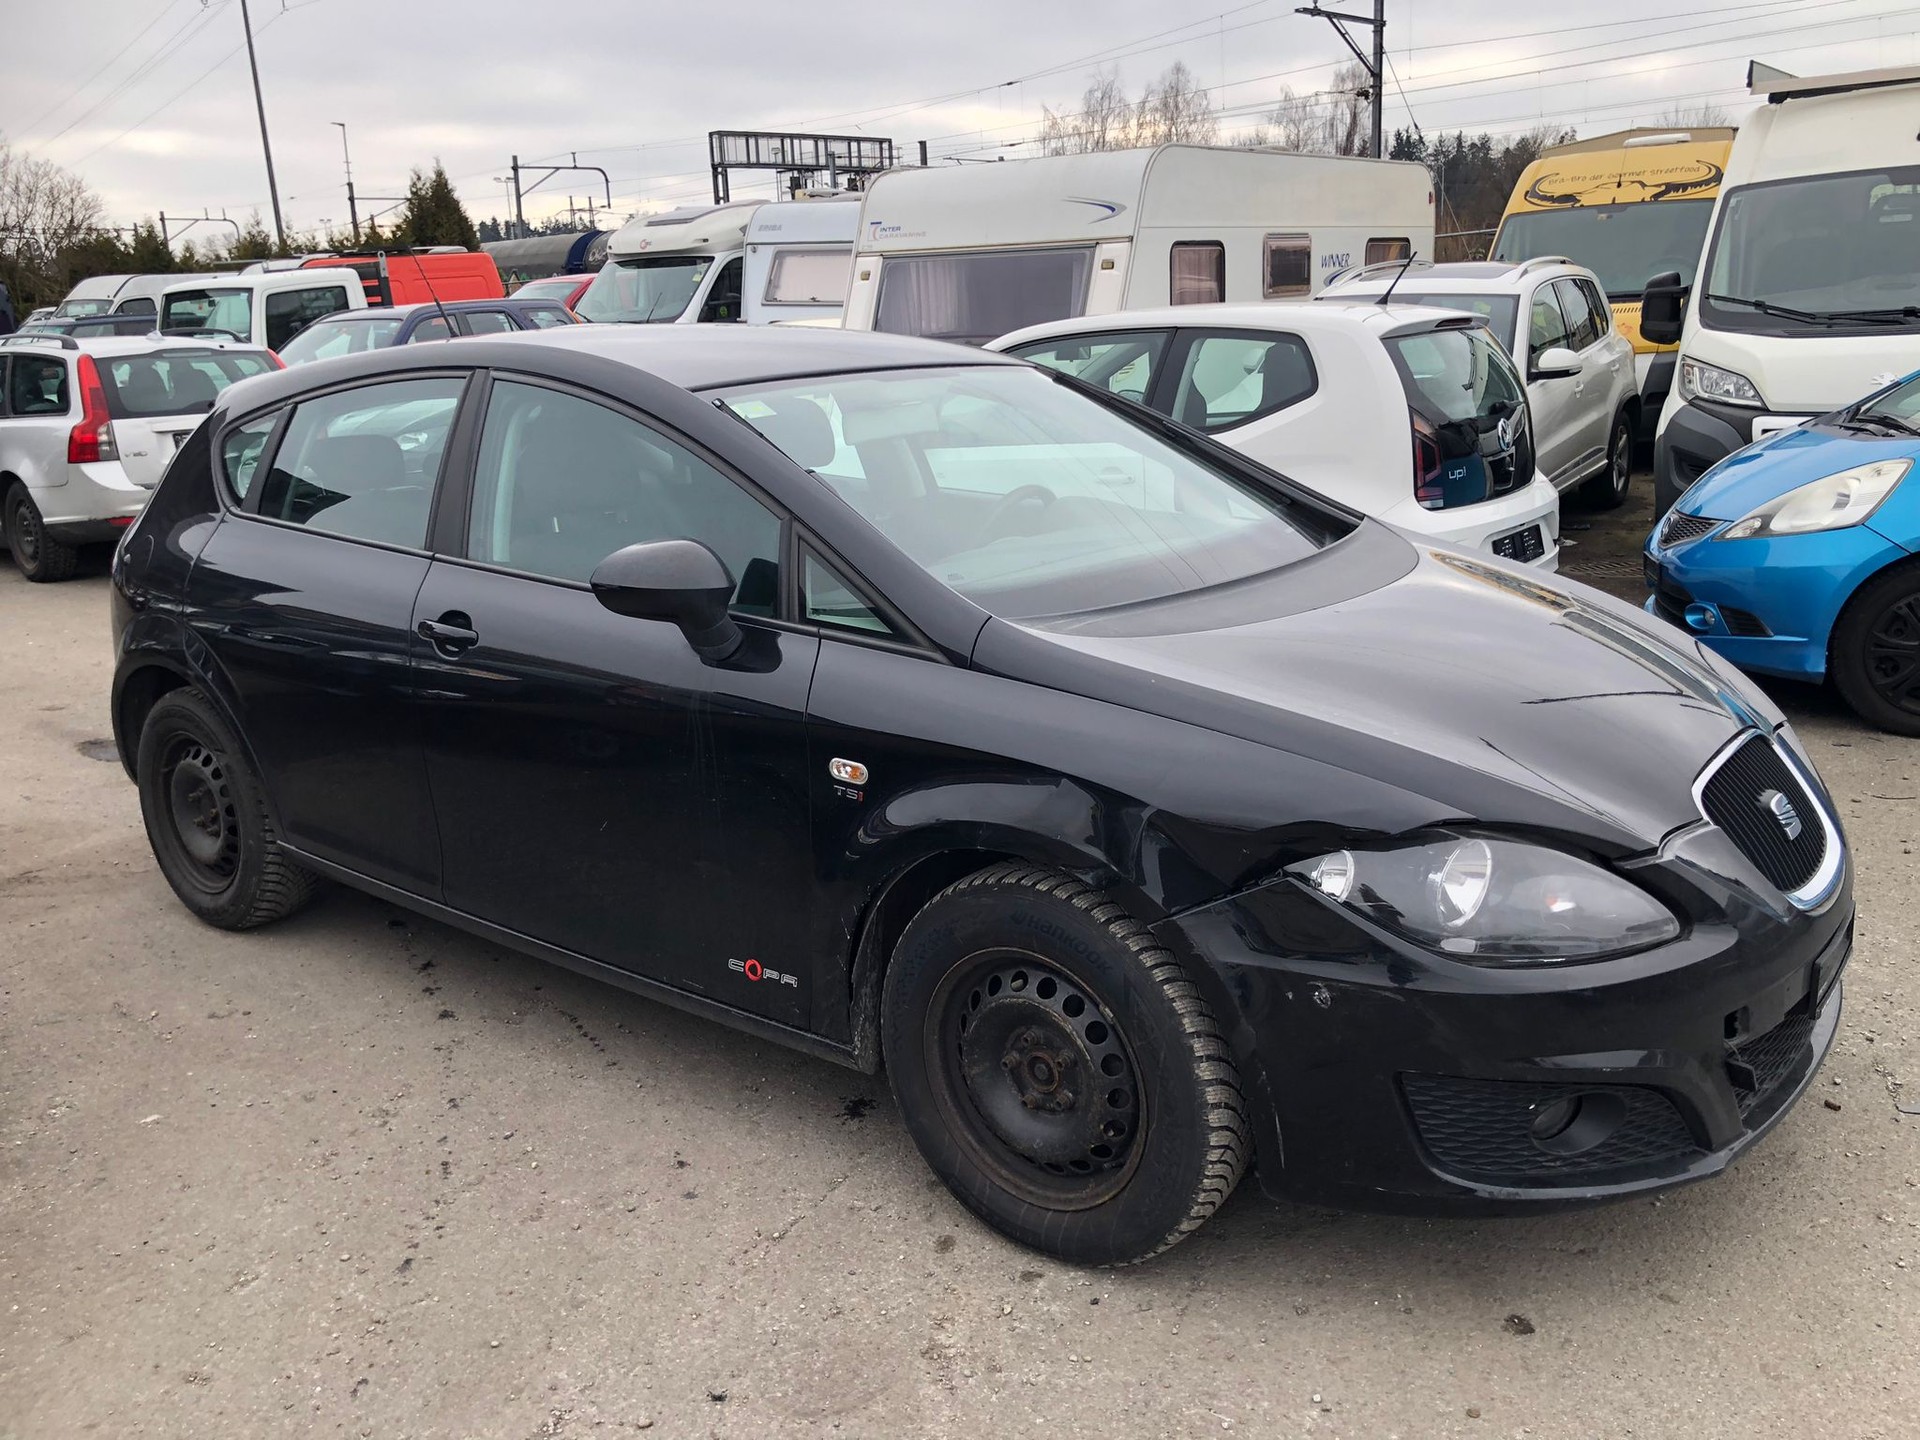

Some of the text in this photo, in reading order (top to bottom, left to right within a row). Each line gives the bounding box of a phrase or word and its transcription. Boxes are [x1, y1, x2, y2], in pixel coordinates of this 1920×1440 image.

[879, 225, 902, 233] INTER
[1321, 253, 1350, 268] WINNER
[1448, 466, 1467, 480] up!
[728, 958, 798, 987] COPA
